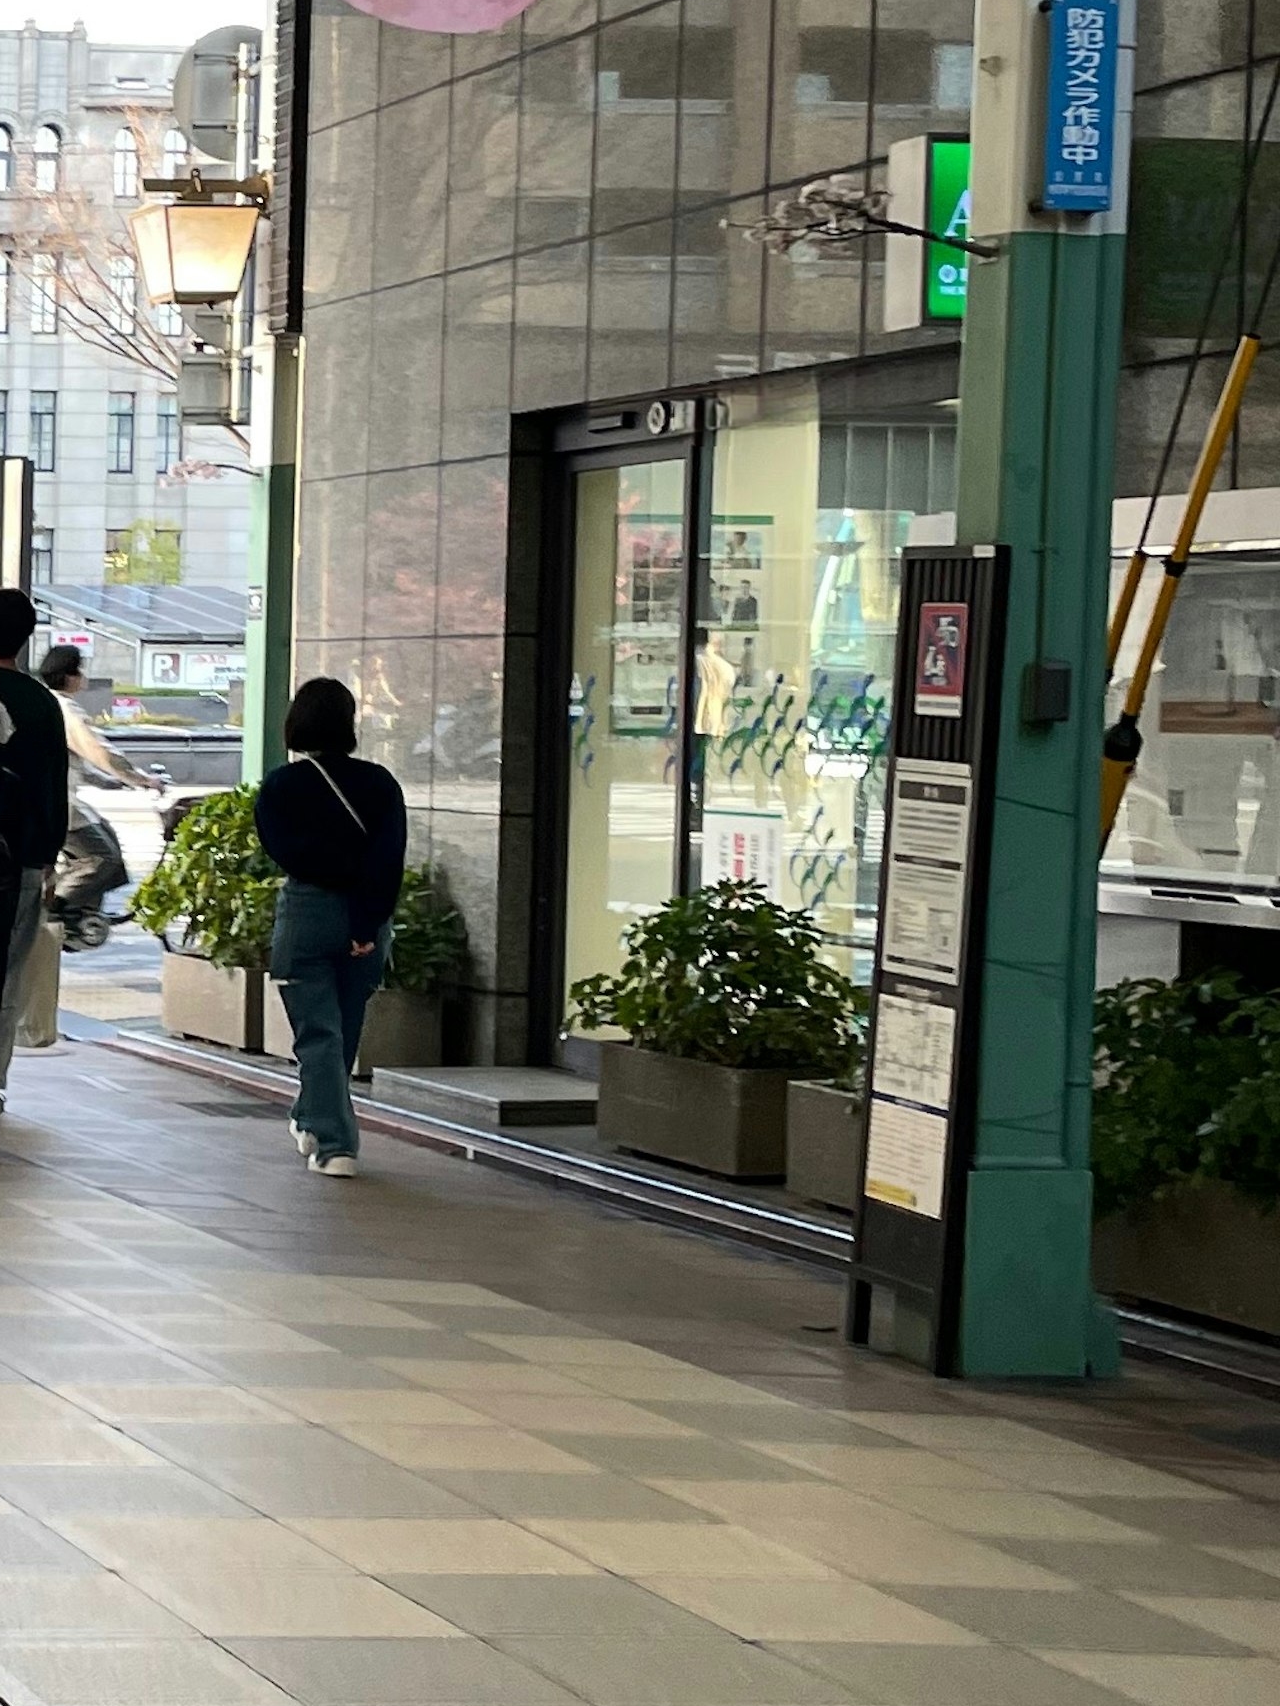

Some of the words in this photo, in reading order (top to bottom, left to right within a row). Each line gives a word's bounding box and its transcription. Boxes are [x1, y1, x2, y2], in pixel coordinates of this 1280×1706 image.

[1061, 7, 1107, 166] 防犯カメラ作動中
